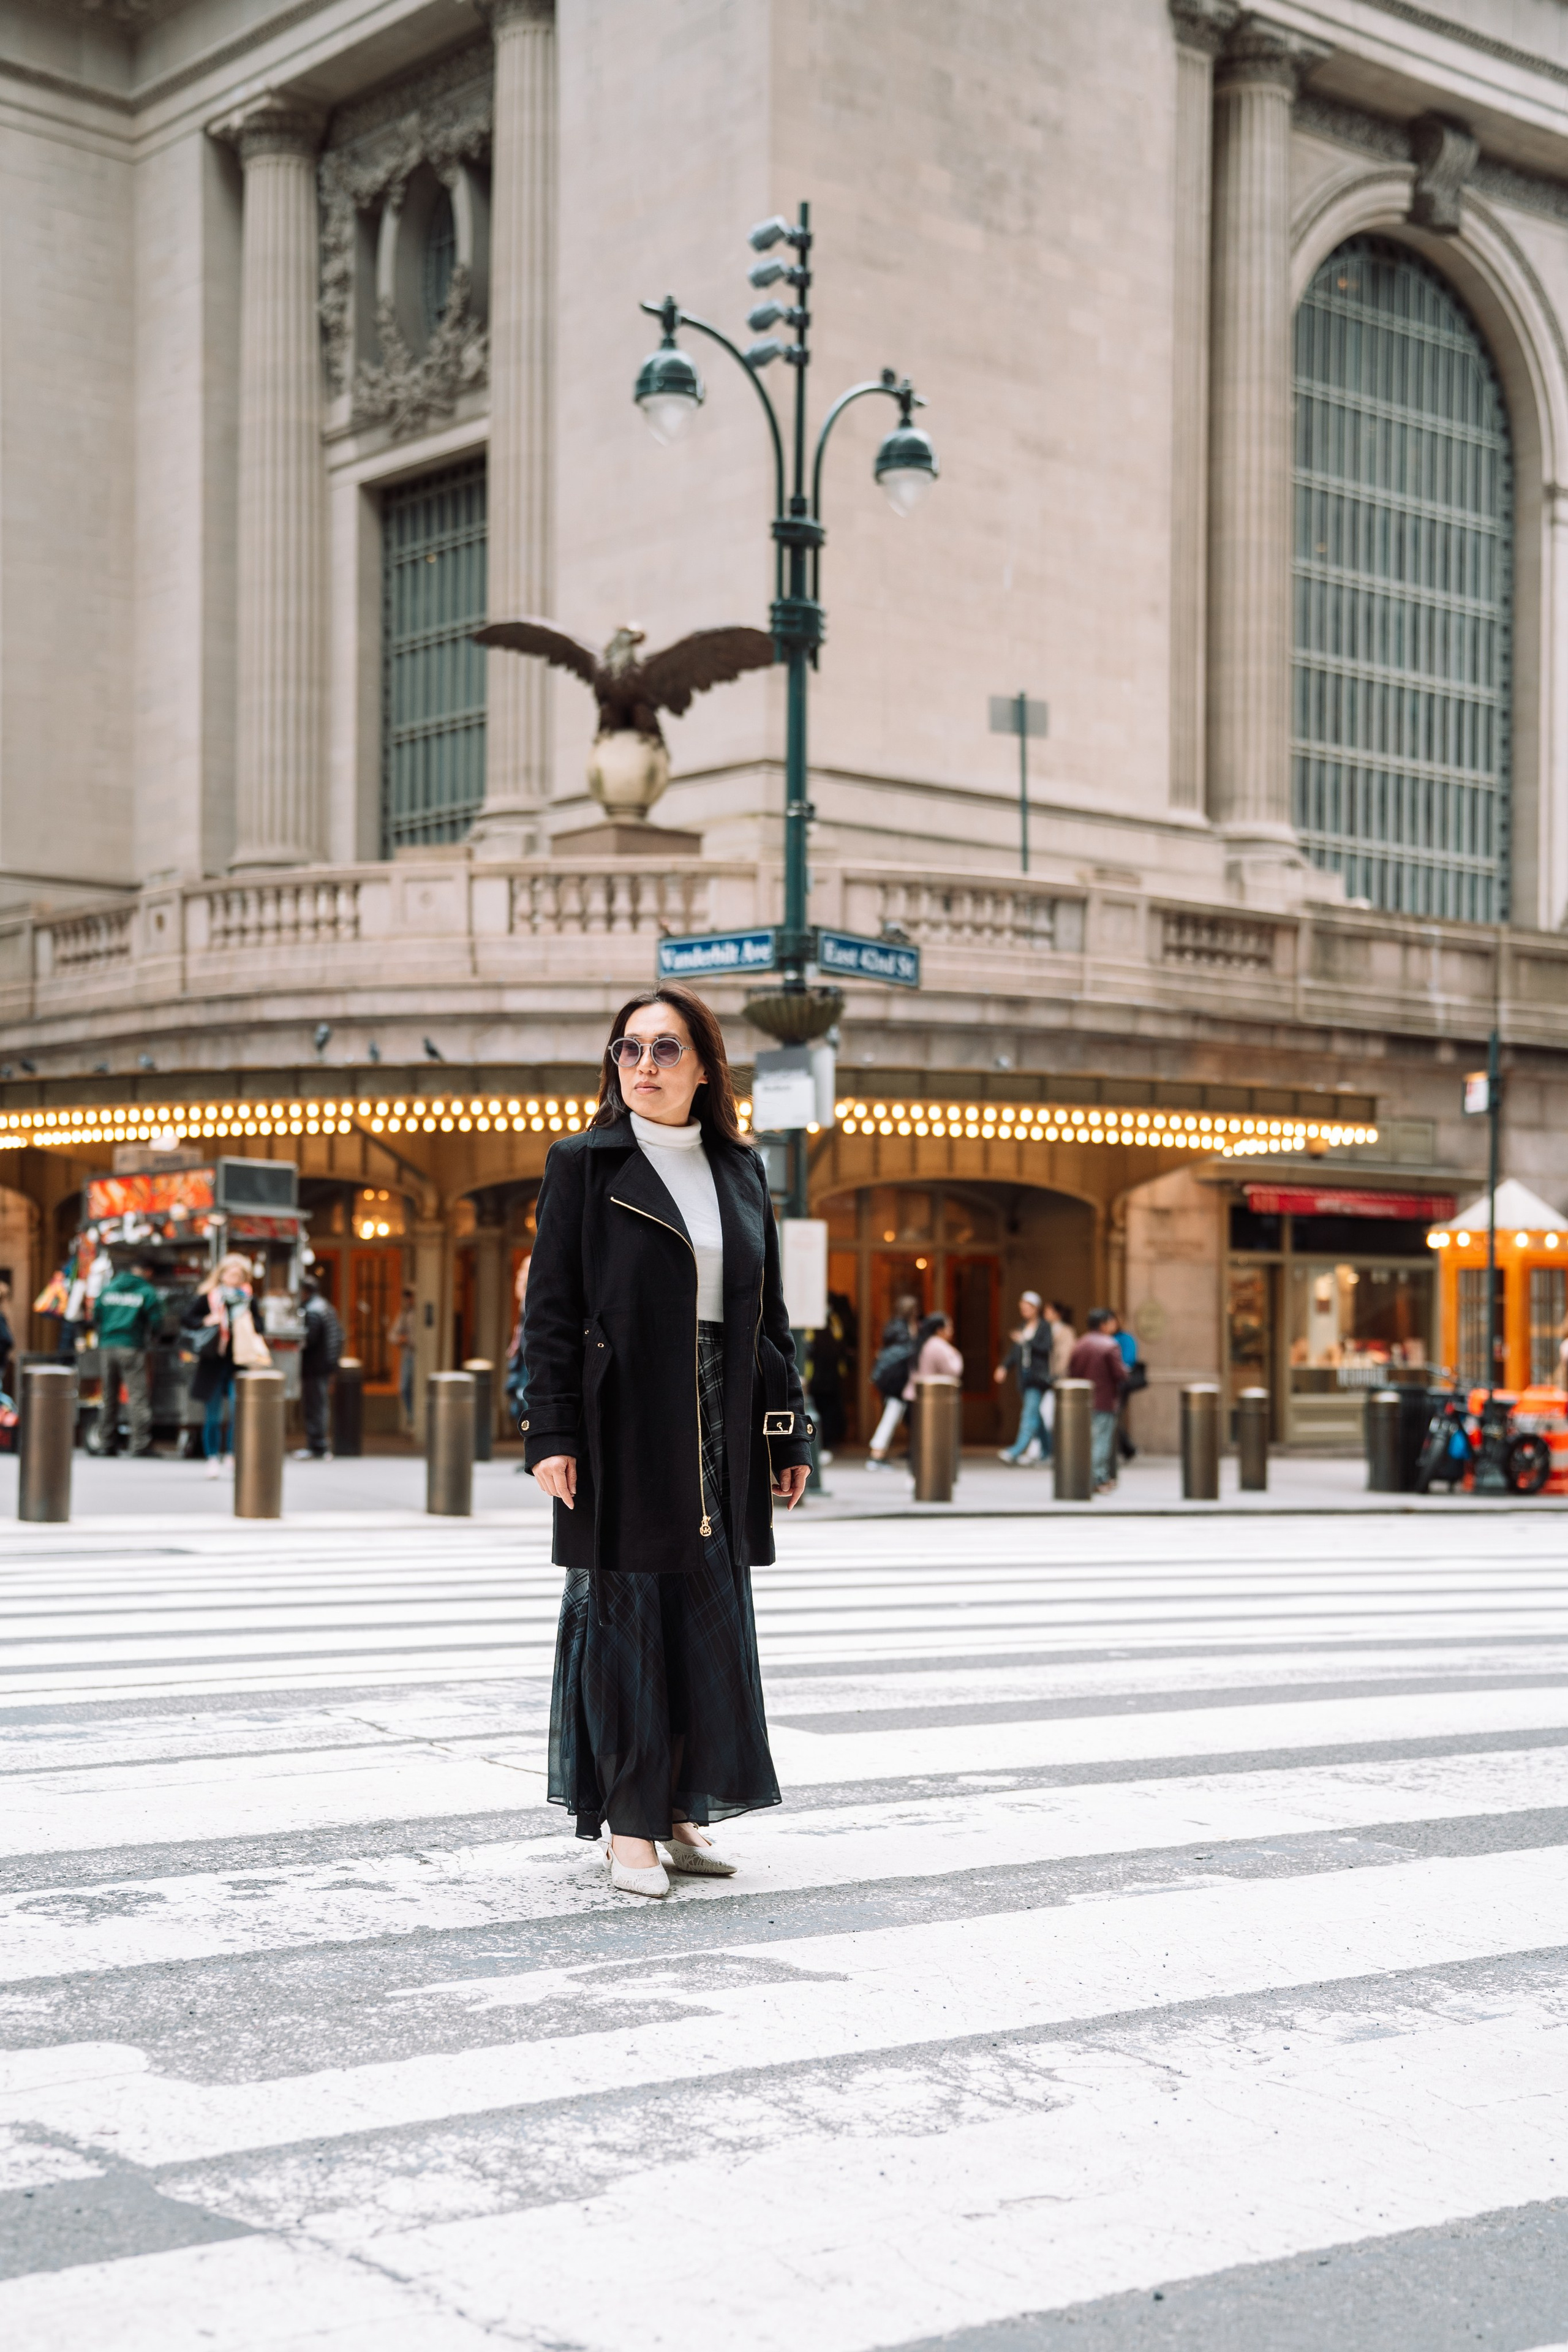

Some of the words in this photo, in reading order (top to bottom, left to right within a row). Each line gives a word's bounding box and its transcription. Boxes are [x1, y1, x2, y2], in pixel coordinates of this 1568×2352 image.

[661, 941, 739, 970] Vanderbilt
[740, 939, 772, 963] Ave
[824, 941, 857, 967] East
[860, 947, 896, 975] 42nd
[897, 954, 914, 978] St
